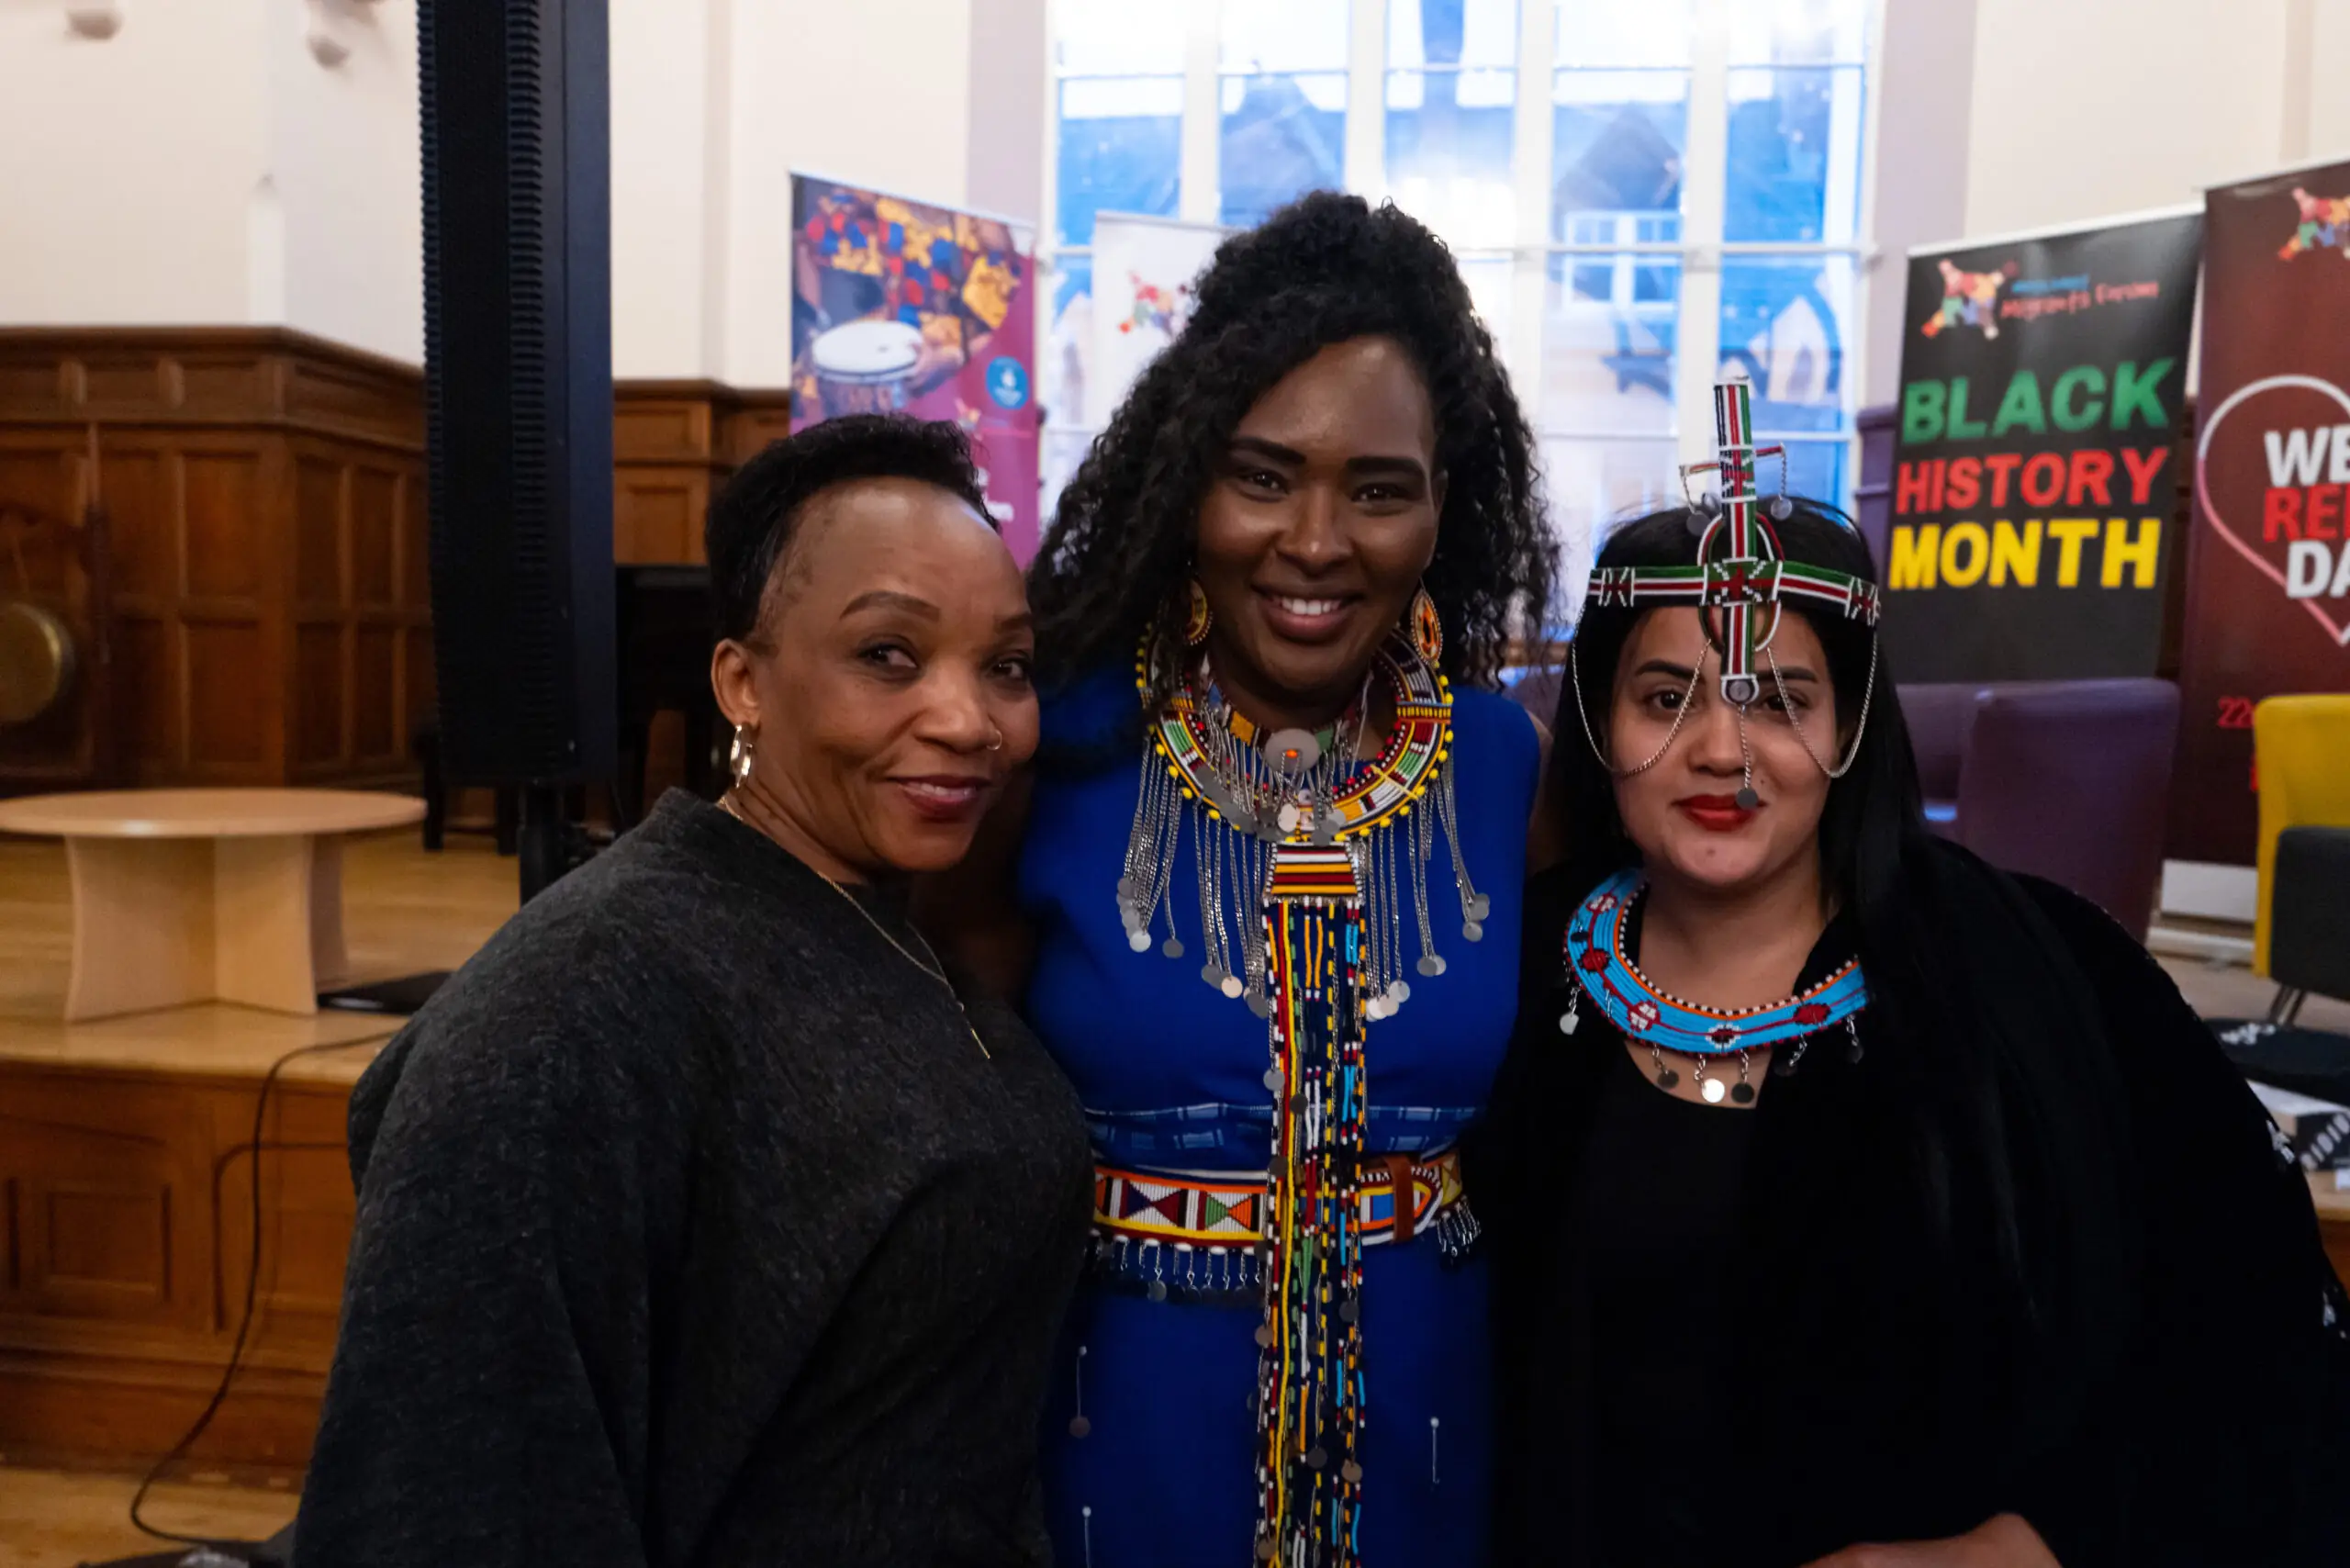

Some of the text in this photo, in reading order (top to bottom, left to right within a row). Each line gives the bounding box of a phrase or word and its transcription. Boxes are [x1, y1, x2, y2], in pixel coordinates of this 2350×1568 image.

[1902, 358, 2174, 444] BLACK
[1896, 447, 2168, 514] HISTORY
[2263, 483, 2350, 543] RE
[1888, 518, 2161, 589] MONTH
